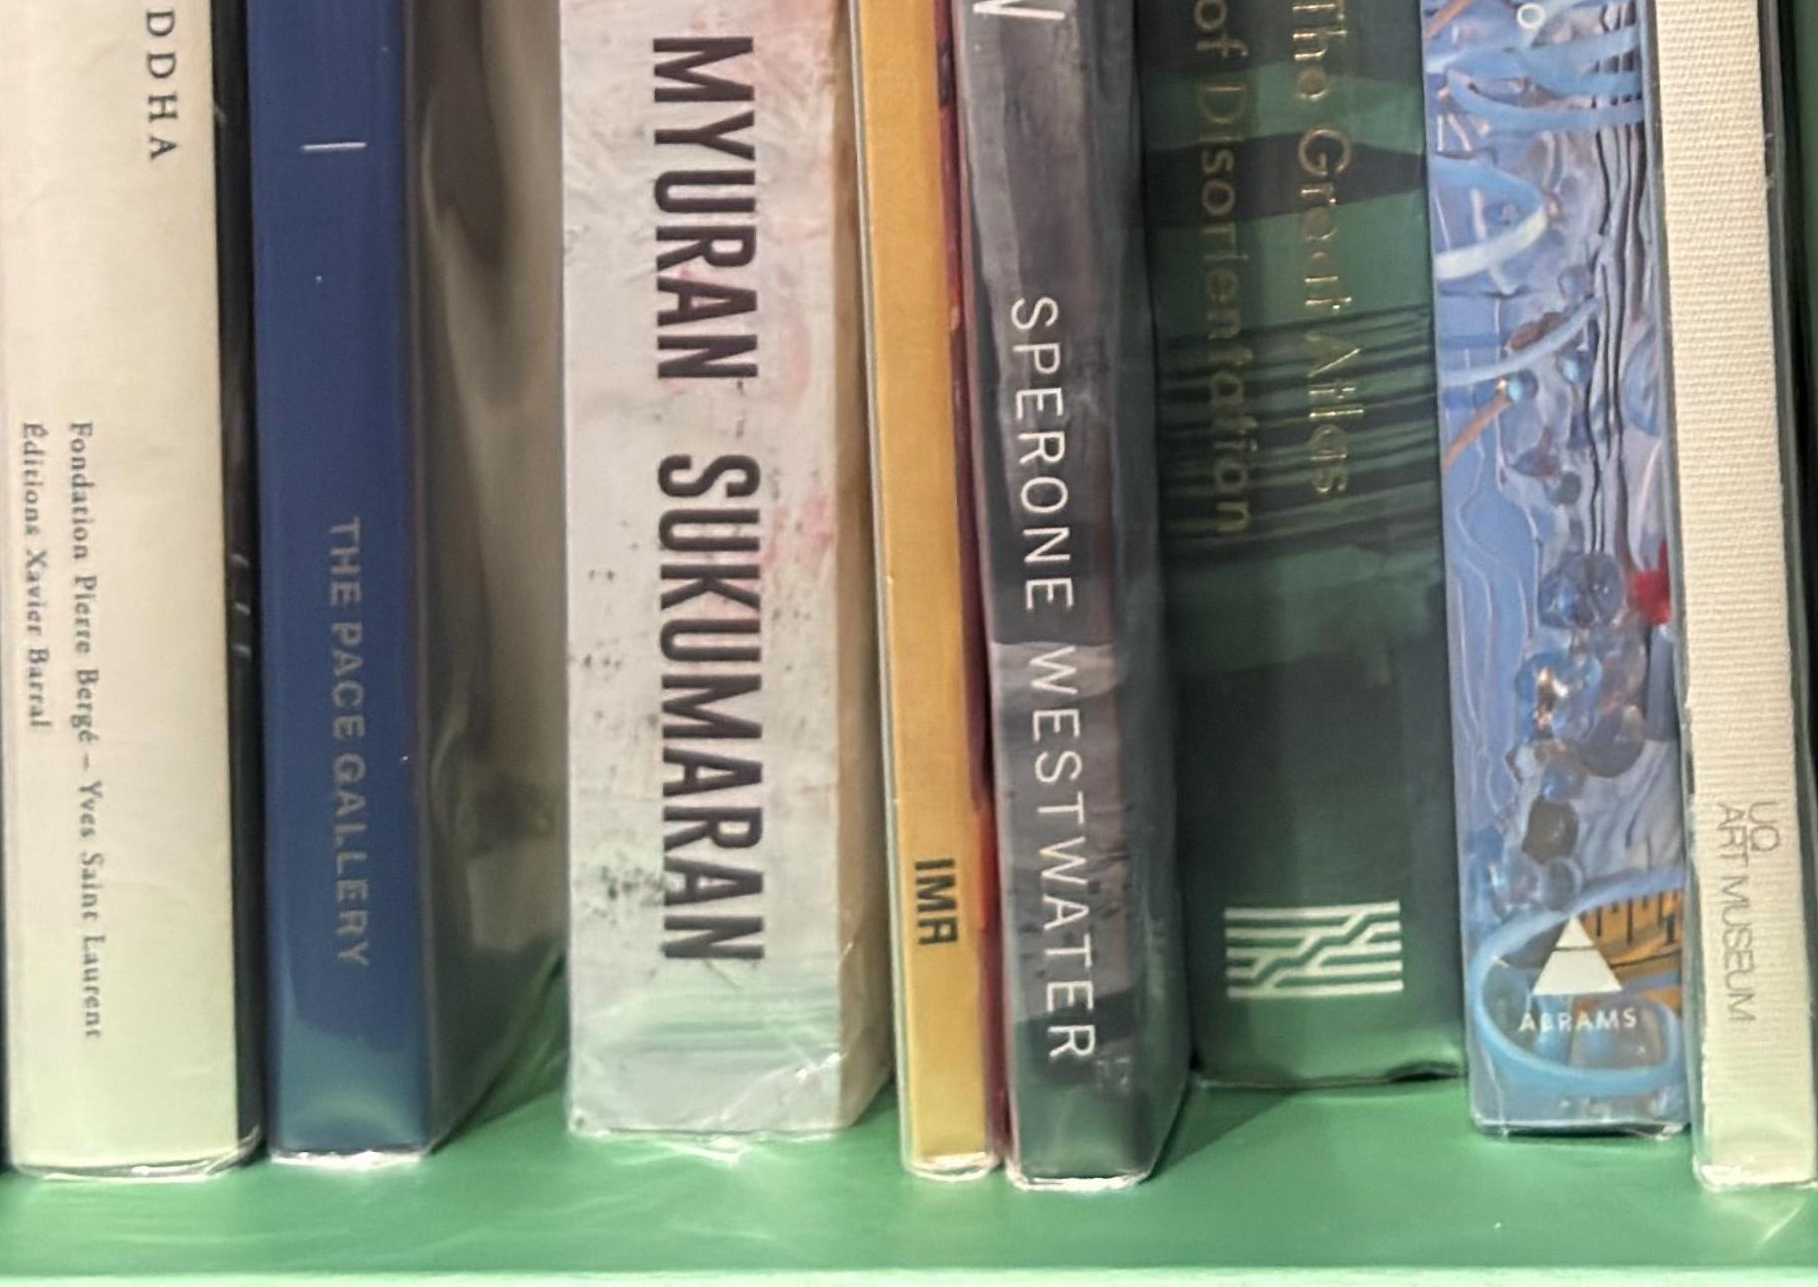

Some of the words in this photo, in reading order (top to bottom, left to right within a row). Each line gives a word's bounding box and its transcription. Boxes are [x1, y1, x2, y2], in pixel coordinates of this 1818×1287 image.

[651, 35, 760, 382] MYURAN
[70, 421, 97, 561] Fondation
[1010, 296, 1076, 613] SPERONE
[25, 547, 49, 638] Xavier
[328, 515, 360, 606] THE
[74, 574, 98, 655] Pierre
[27, 646, 53, 729] Barral
[69, 668, 101, 745] Bergé
[331, 630, 363, 741] PACE
[655, 453, 765, 963] SUKUMARAN
[78, 779, 104, 839] Yves
[1027, 643, 1099, 1062] WESTWATER
[1717, 802, 1750, 869] ART
[1746, 799, 1781, 854] UQ
[81, 851, 106, 922] Saint
[333, 752, 373, 970] GALLERY
[82, 932, 107, 1040] Laurent
[1720, 874, 1757, 1025] MUSEUM
